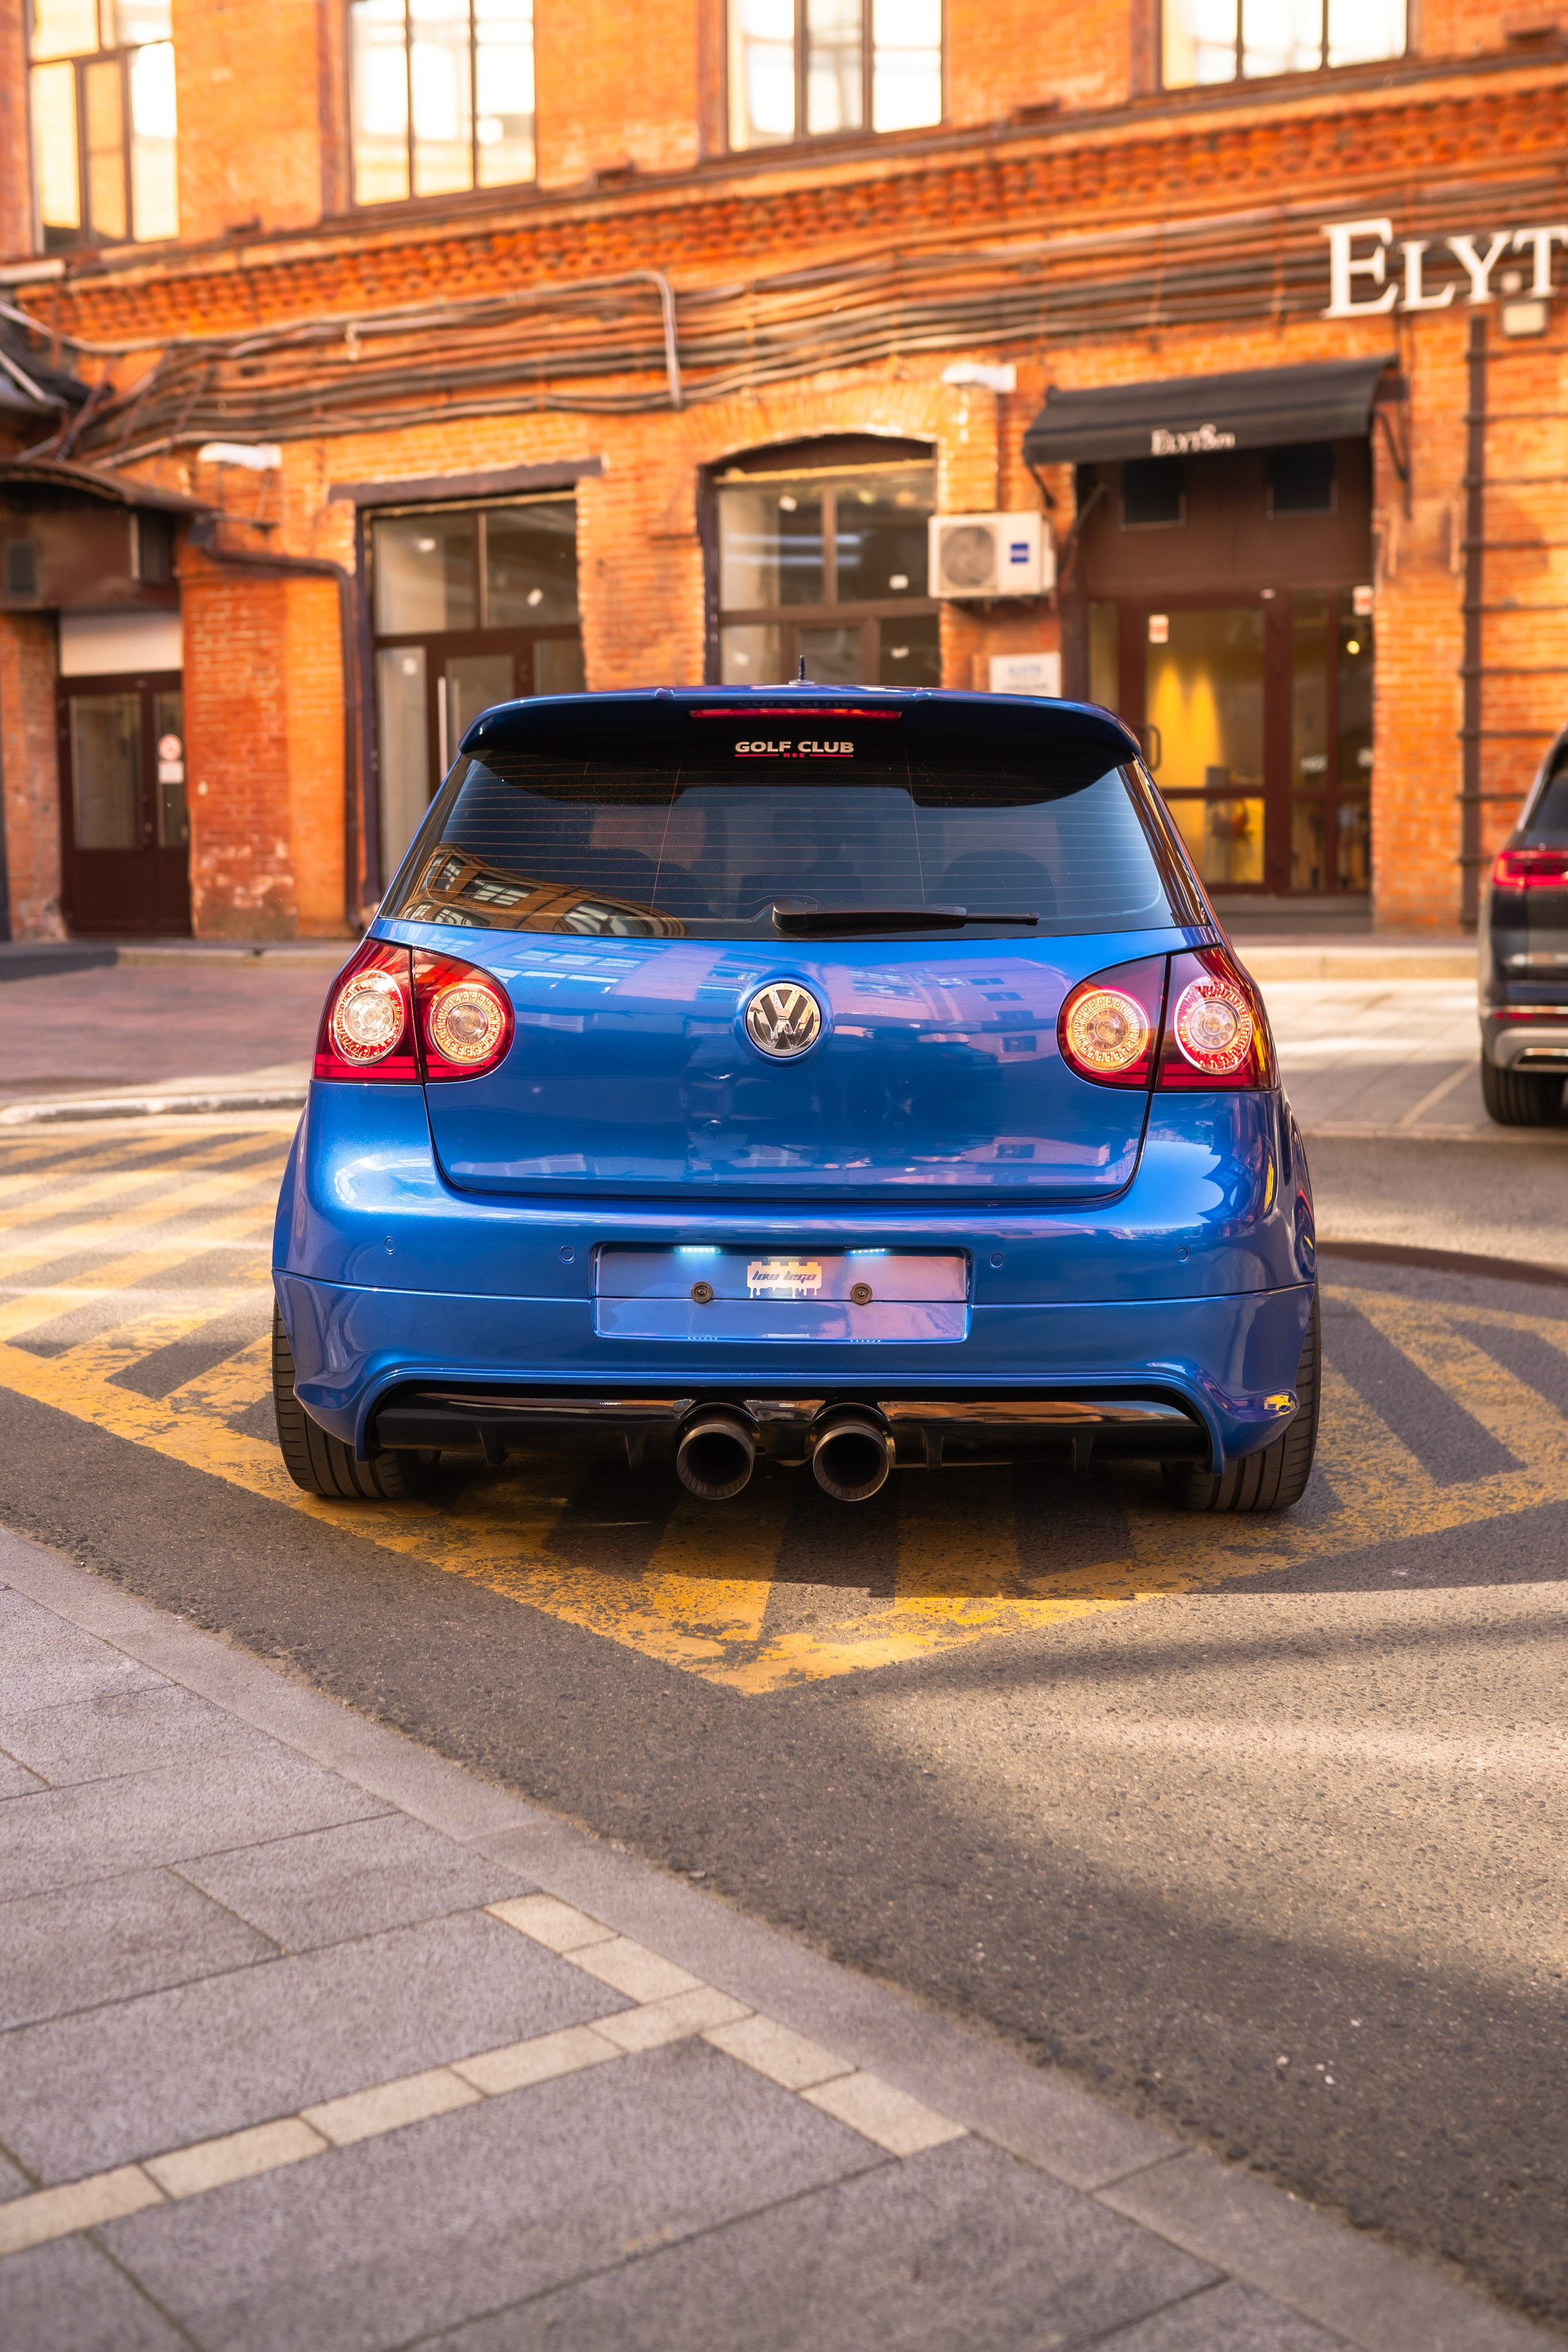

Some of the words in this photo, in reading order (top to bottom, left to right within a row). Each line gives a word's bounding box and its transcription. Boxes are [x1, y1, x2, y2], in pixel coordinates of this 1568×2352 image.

[735, 741, 791, 753] GOLF
[797, 741, 854, 753] CLUB
[752, 1270, 780, 1281] low
[783, 1270, 818, 1284] lego
